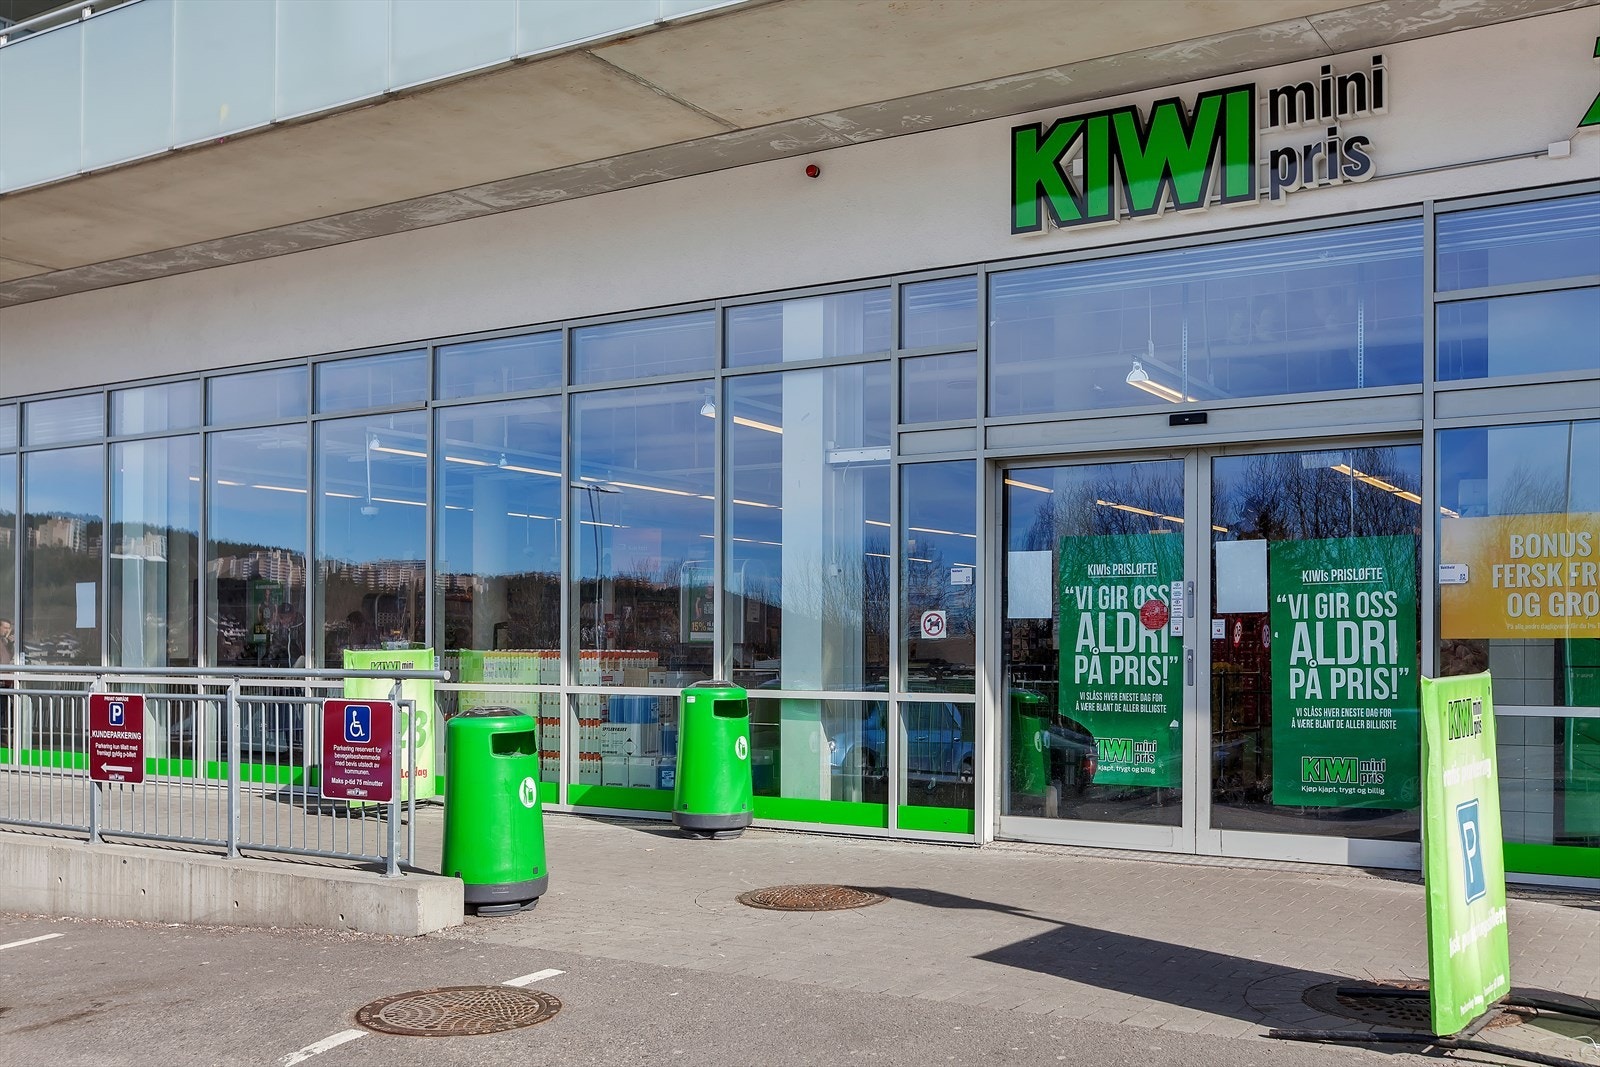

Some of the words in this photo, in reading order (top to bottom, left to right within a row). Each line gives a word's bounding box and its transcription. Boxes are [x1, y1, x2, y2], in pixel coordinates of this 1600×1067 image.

[1269, 54, 1386, 127] mini
[1010, 82, 1257, 236] KIWI
[1269, 126, 1376, 200] pris
[1510, 532, 1592, 559] BONUS
[1088, 564, 1110, 576] KIWIs
[1112, 562, 1158, 575] PRISLØFTE
[1302, 570, 1328, 582] KIWIs
[1330, 568, 1382, 581] PRISLØFTE
[1492, 562, 1562, 588] FERSK
[1570, 562, 1600, 586] FR
[1099, 586, 1128, 610] GIR
[1314, 592, 1349, 618] GIR
[1356, 591, 1398, 618] OSS
[1507, 592, 1541, 617] OG
[1076, 612, 1168, 653] ALDRI
[1290, 620, 1398, 665] ALDRI
[402, 661, 414, 669] mini
[1074, 646, 1103, 684] PÅ
[1290, 658, 1322, 700] PÅ
[1076, 700, 1080, 711] Å
[1080, 702, 1096, 712] VÆRE
[1096, 703, 1114, 712] BLANT
[1114, 704, 1122, 712] DE
[1122, 704, 1140, 712] ALLER
[1140, 704, 1167, 714] BILLIGSTE
[1080, 692, 1086, 700] VI
[1086, 690, 1102, 700] SLÅSS
[1104, 692, 1118, 701] HVER
[1120, 692, 1138, 702] ENESTE
[1140, 693, 1151, 702] DAG
[1152, 694, 1162, 702] FOR
[112, 704, 122, 722] P
[1292, 717, 1296, 728] Å
[1297, 720, 1314, 728] VÆRE
[1316, 720, 1334, 728] BLANT
[1336, 720, 1344, 728] DE
[1346, 720, 1364, 729] ALLER
[1366, 720, 1396, 730] BILLIGSTE
[1296, 708, 1302, 716] VI
[1304, 706, 1322, 716] SLÅSS
[1324, 708, 1340, 717] HVER
[1342, 708, 1364, 717] ENESTE
[1366, 708, 1378, 718] DAG
[1380, 708, 1392, 718] FOR
[92, 730, 142, 740] KUNDEPARKERING
[334, 744, 354, 753] Parkering
[334, 752, 380, 760] bevegelseshemmede
[1094, 737, 1134, 763] IWI
[1134, 740, 1157, 752] mini
[1134, 752, 1155, 765] pris
[1302, 756, 1358, 783] KIWI
[1360, 758, 1386, 772] mini
[1360, 772, 1384, 786] pris
[1462, 820, 1476, 884] P
